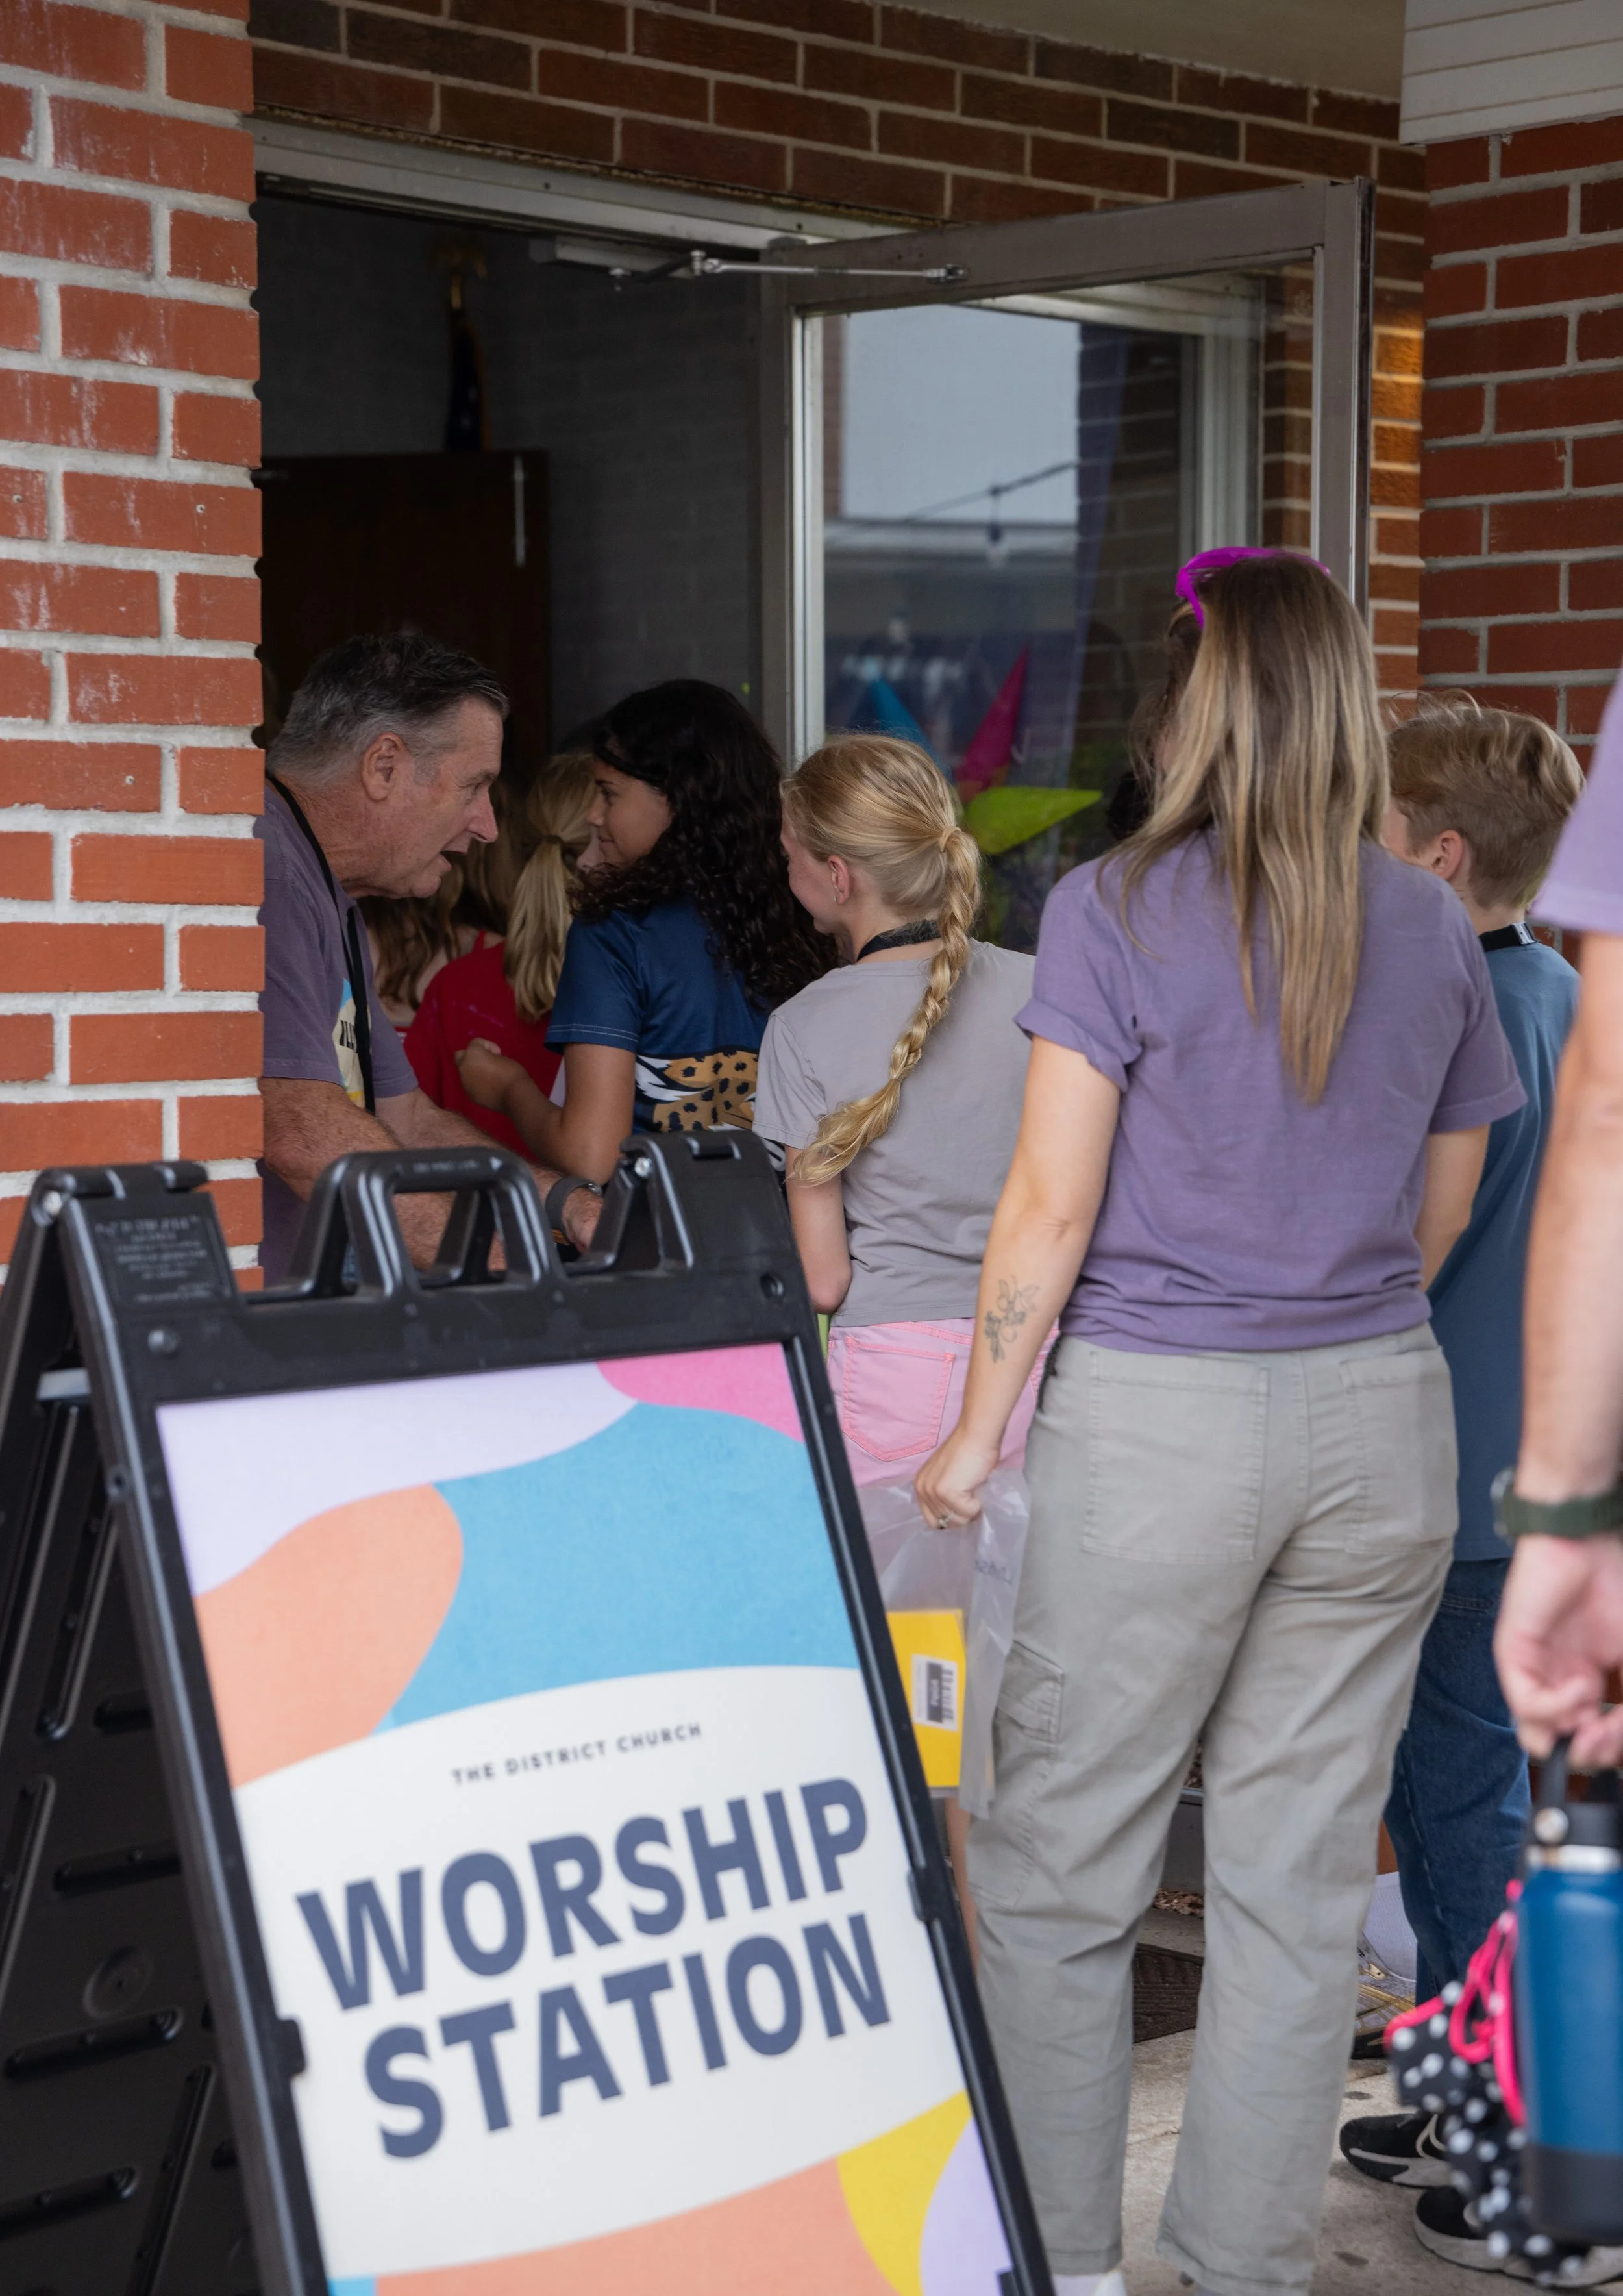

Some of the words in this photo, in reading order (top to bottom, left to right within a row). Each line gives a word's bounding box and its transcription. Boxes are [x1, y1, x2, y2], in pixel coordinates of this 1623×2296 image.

[452, 1763, 494, 1783] THE
[506, 1740, 606, 1775] DISTRICT
[616, 1723, 702, 1753] CHURCH
[296, 1778, 868, 2011] WORSHIP
[364, 1913, 891, 2159] STATION
